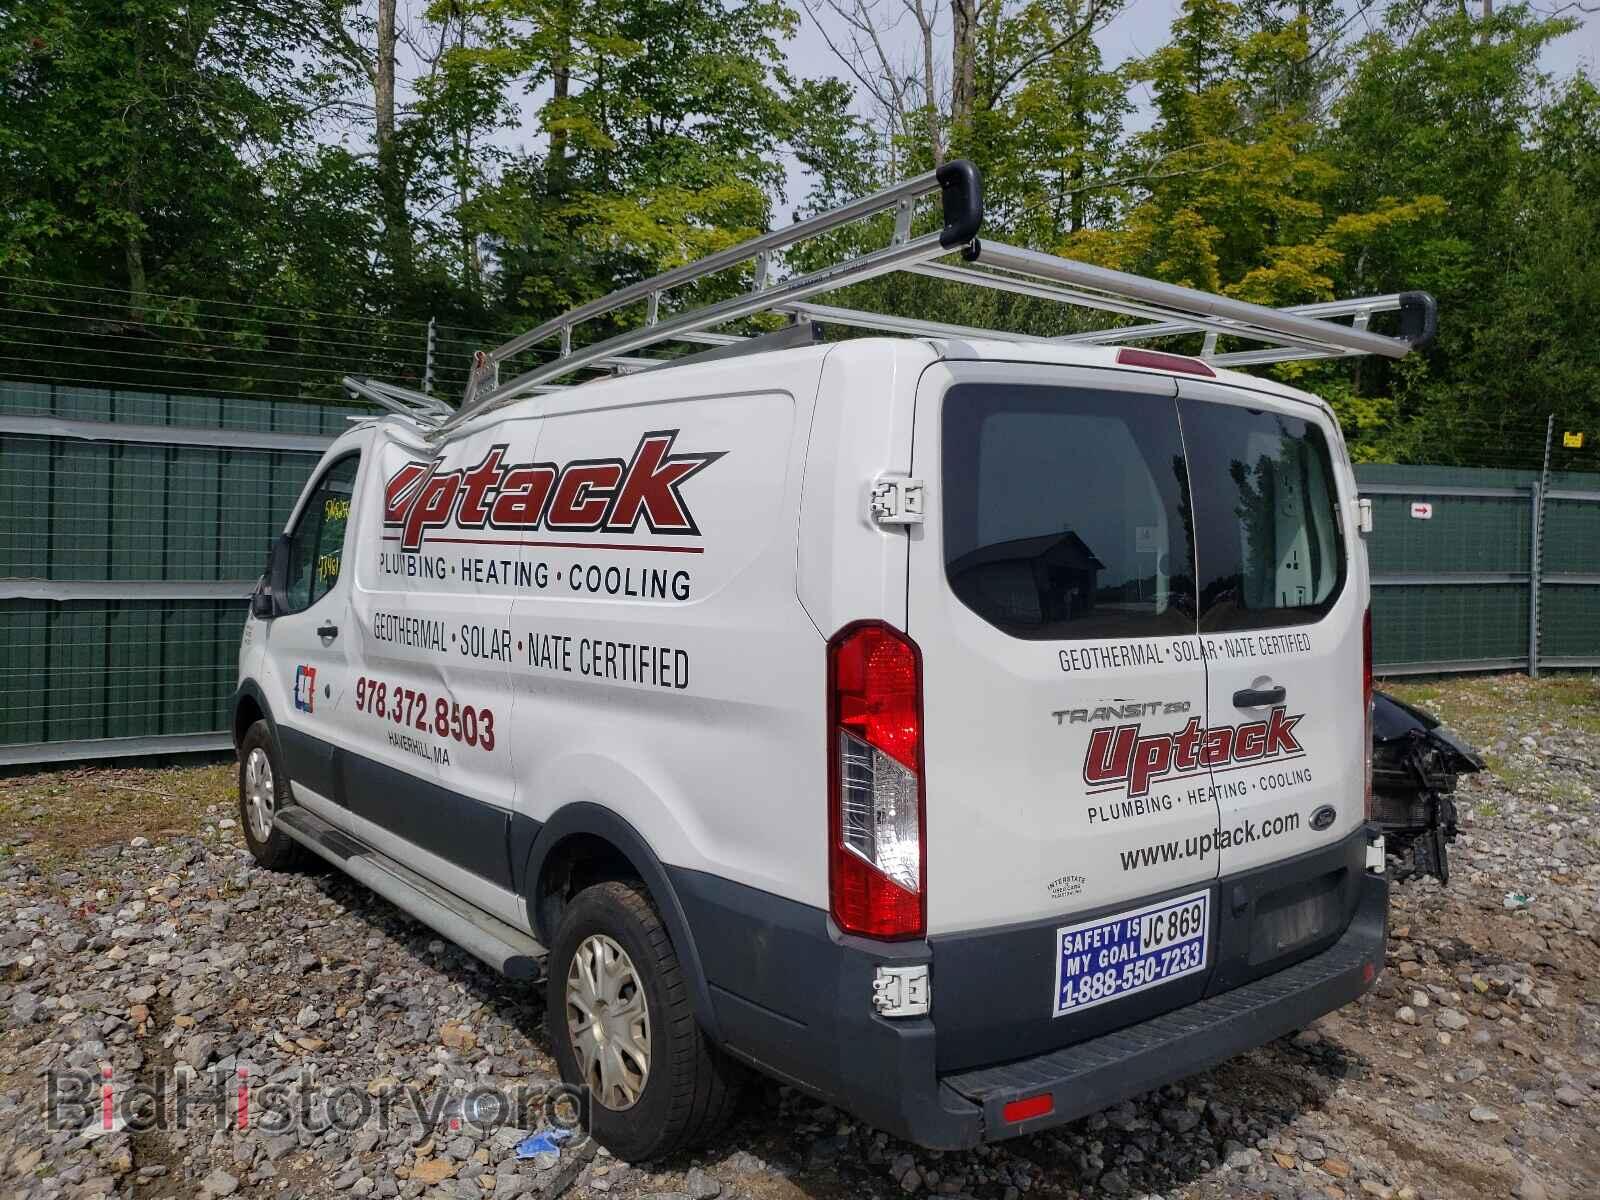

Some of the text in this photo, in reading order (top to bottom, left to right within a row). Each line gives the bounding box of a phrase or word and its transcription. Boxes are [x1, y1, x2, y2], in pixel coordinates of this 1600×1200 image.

[384, 429, 731, 553] Uptack
[379, 553, 691, 600] PLUMBING HEATING COOLING
[374, 612, 690, 690] GEOTHERMAL SOLAR NATE CERTIFIED
[1058, 632, 1312, 672] GEOTHERMAL SOLAR NATE CERTIFIED
[355, 676, 496, 752] 978.372.8503
[1052, 701, 1163, 725] TRANSIT
[433, 747, 451, 767] MA
[1082, 705, 1306, 799] Uptack
[1088, 768, 1312, 824] PLUMBING HEATING COOLING
[1120, 811, 1300, 871] www.uptack.com
[1047, 875, 1086, 891] INTERSTATE
[1063, 917, 1141, 955] SAFETY IS
[1143, 904, 1202, 948] JC 869
[1061, 942, 1201, 1009] 1-888-550-7233
[1066, 943, 1139, 977] MY GOAL
